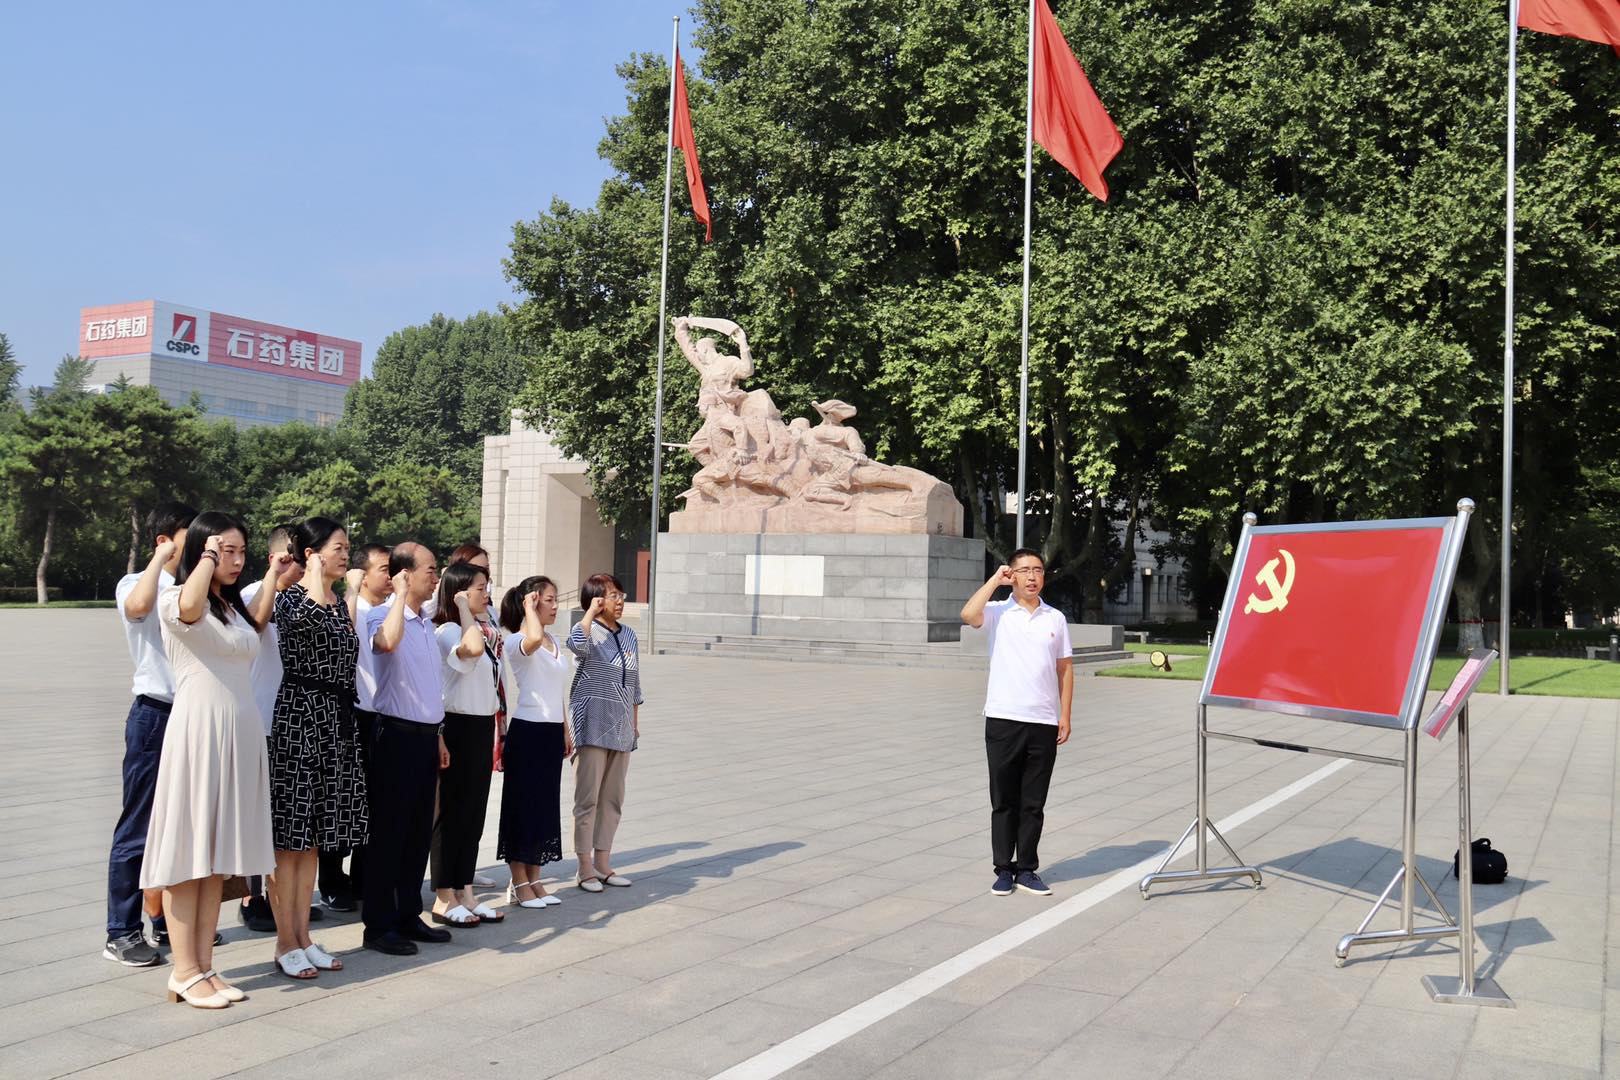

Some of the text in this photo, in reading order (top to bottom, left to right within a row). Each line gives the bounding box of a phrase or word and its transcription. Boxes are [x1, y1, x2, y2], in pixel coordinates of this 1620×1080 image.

[86, 315, 147, 342] 石药集团
[166, 340, 200, 356] CSPC
[226, 327, 344, 376] 石药集团
